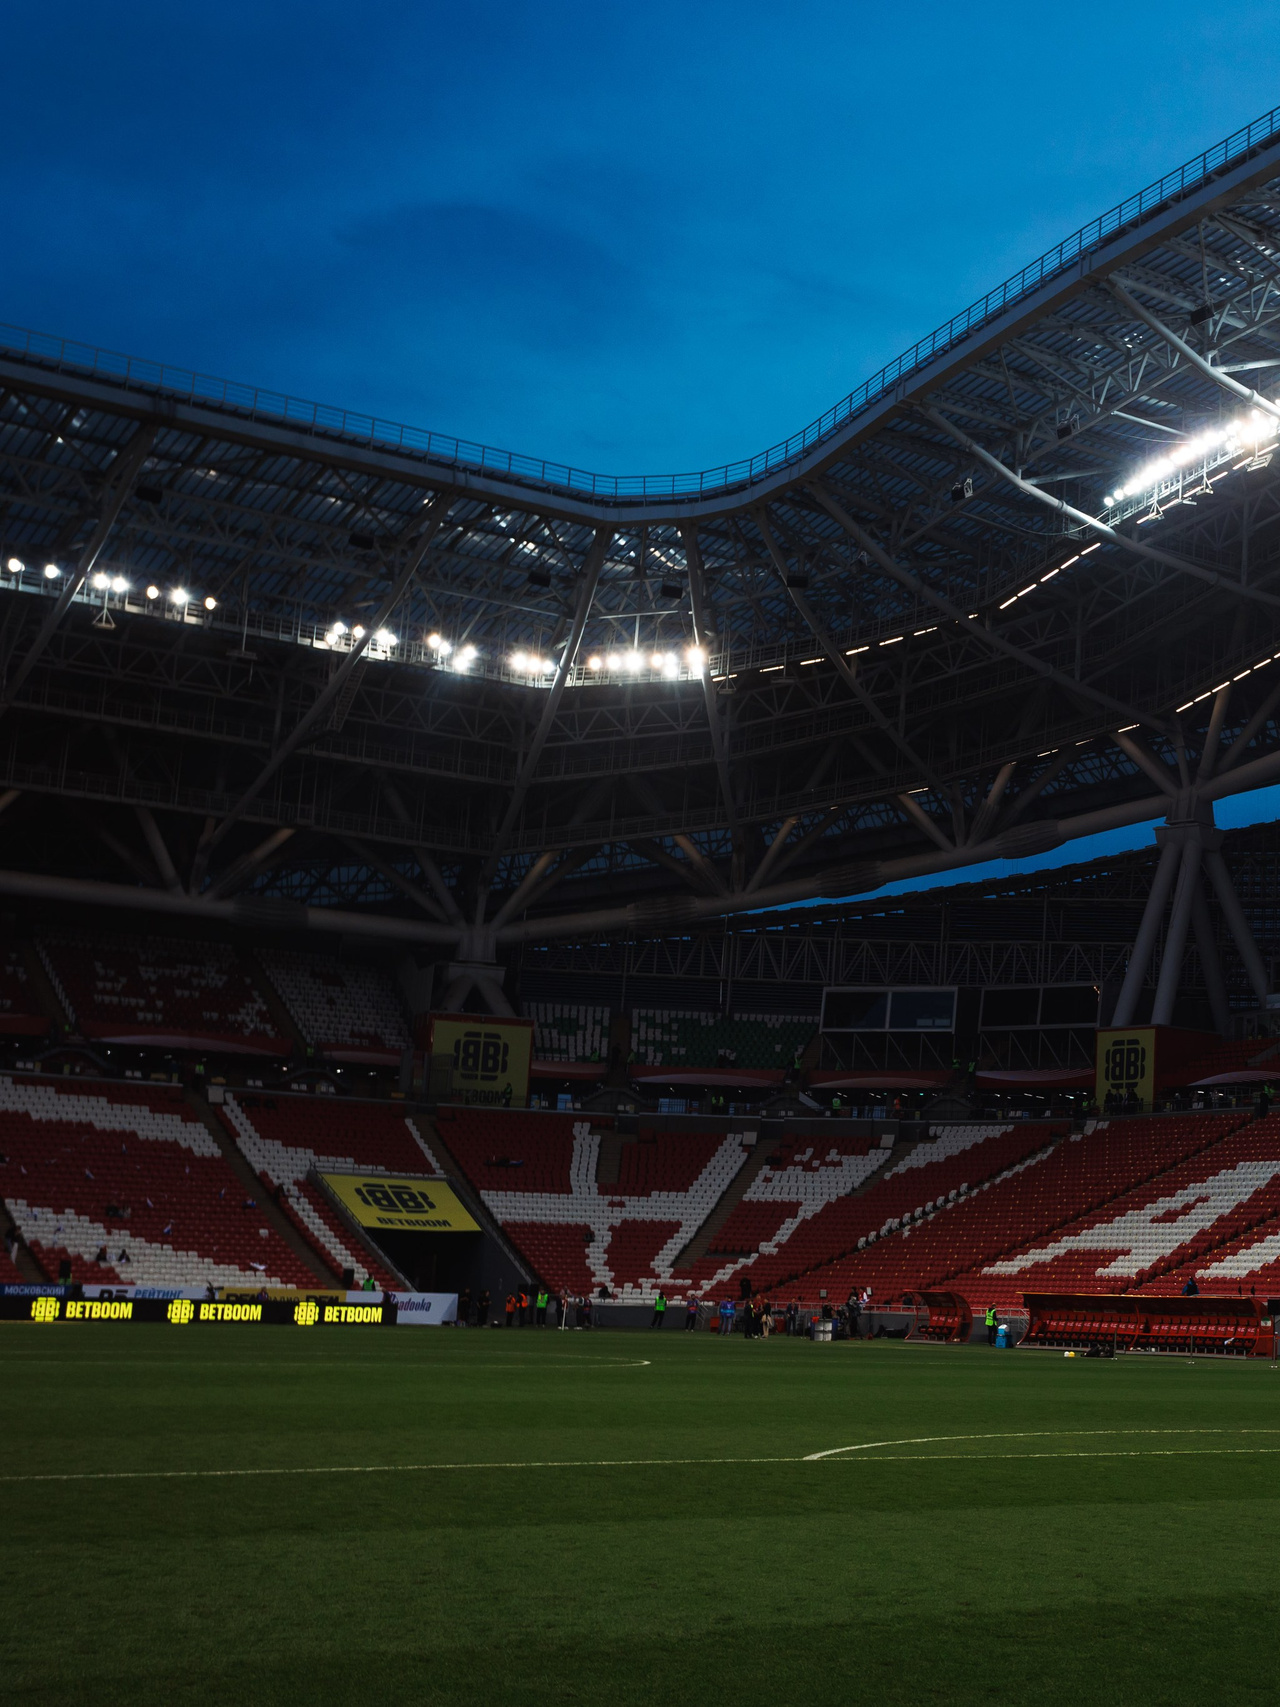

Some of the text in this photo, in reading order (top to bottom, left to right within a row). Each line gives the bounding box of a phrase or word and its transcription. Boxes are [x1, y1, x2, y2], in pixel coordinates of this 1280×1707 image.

[376, 1217, 452, 1228] BETBOOM
[4, 1285, 65, 1296] МОСКОВСКИЙ
[134, 1288, 183, 1299] РЕЙТИНГ
[66, 1301, 133, 1319] BETBOOM
[199, 1303, 262, 1321] BETBOOM
[324, 1306, 382, 1323] BETBOOM
